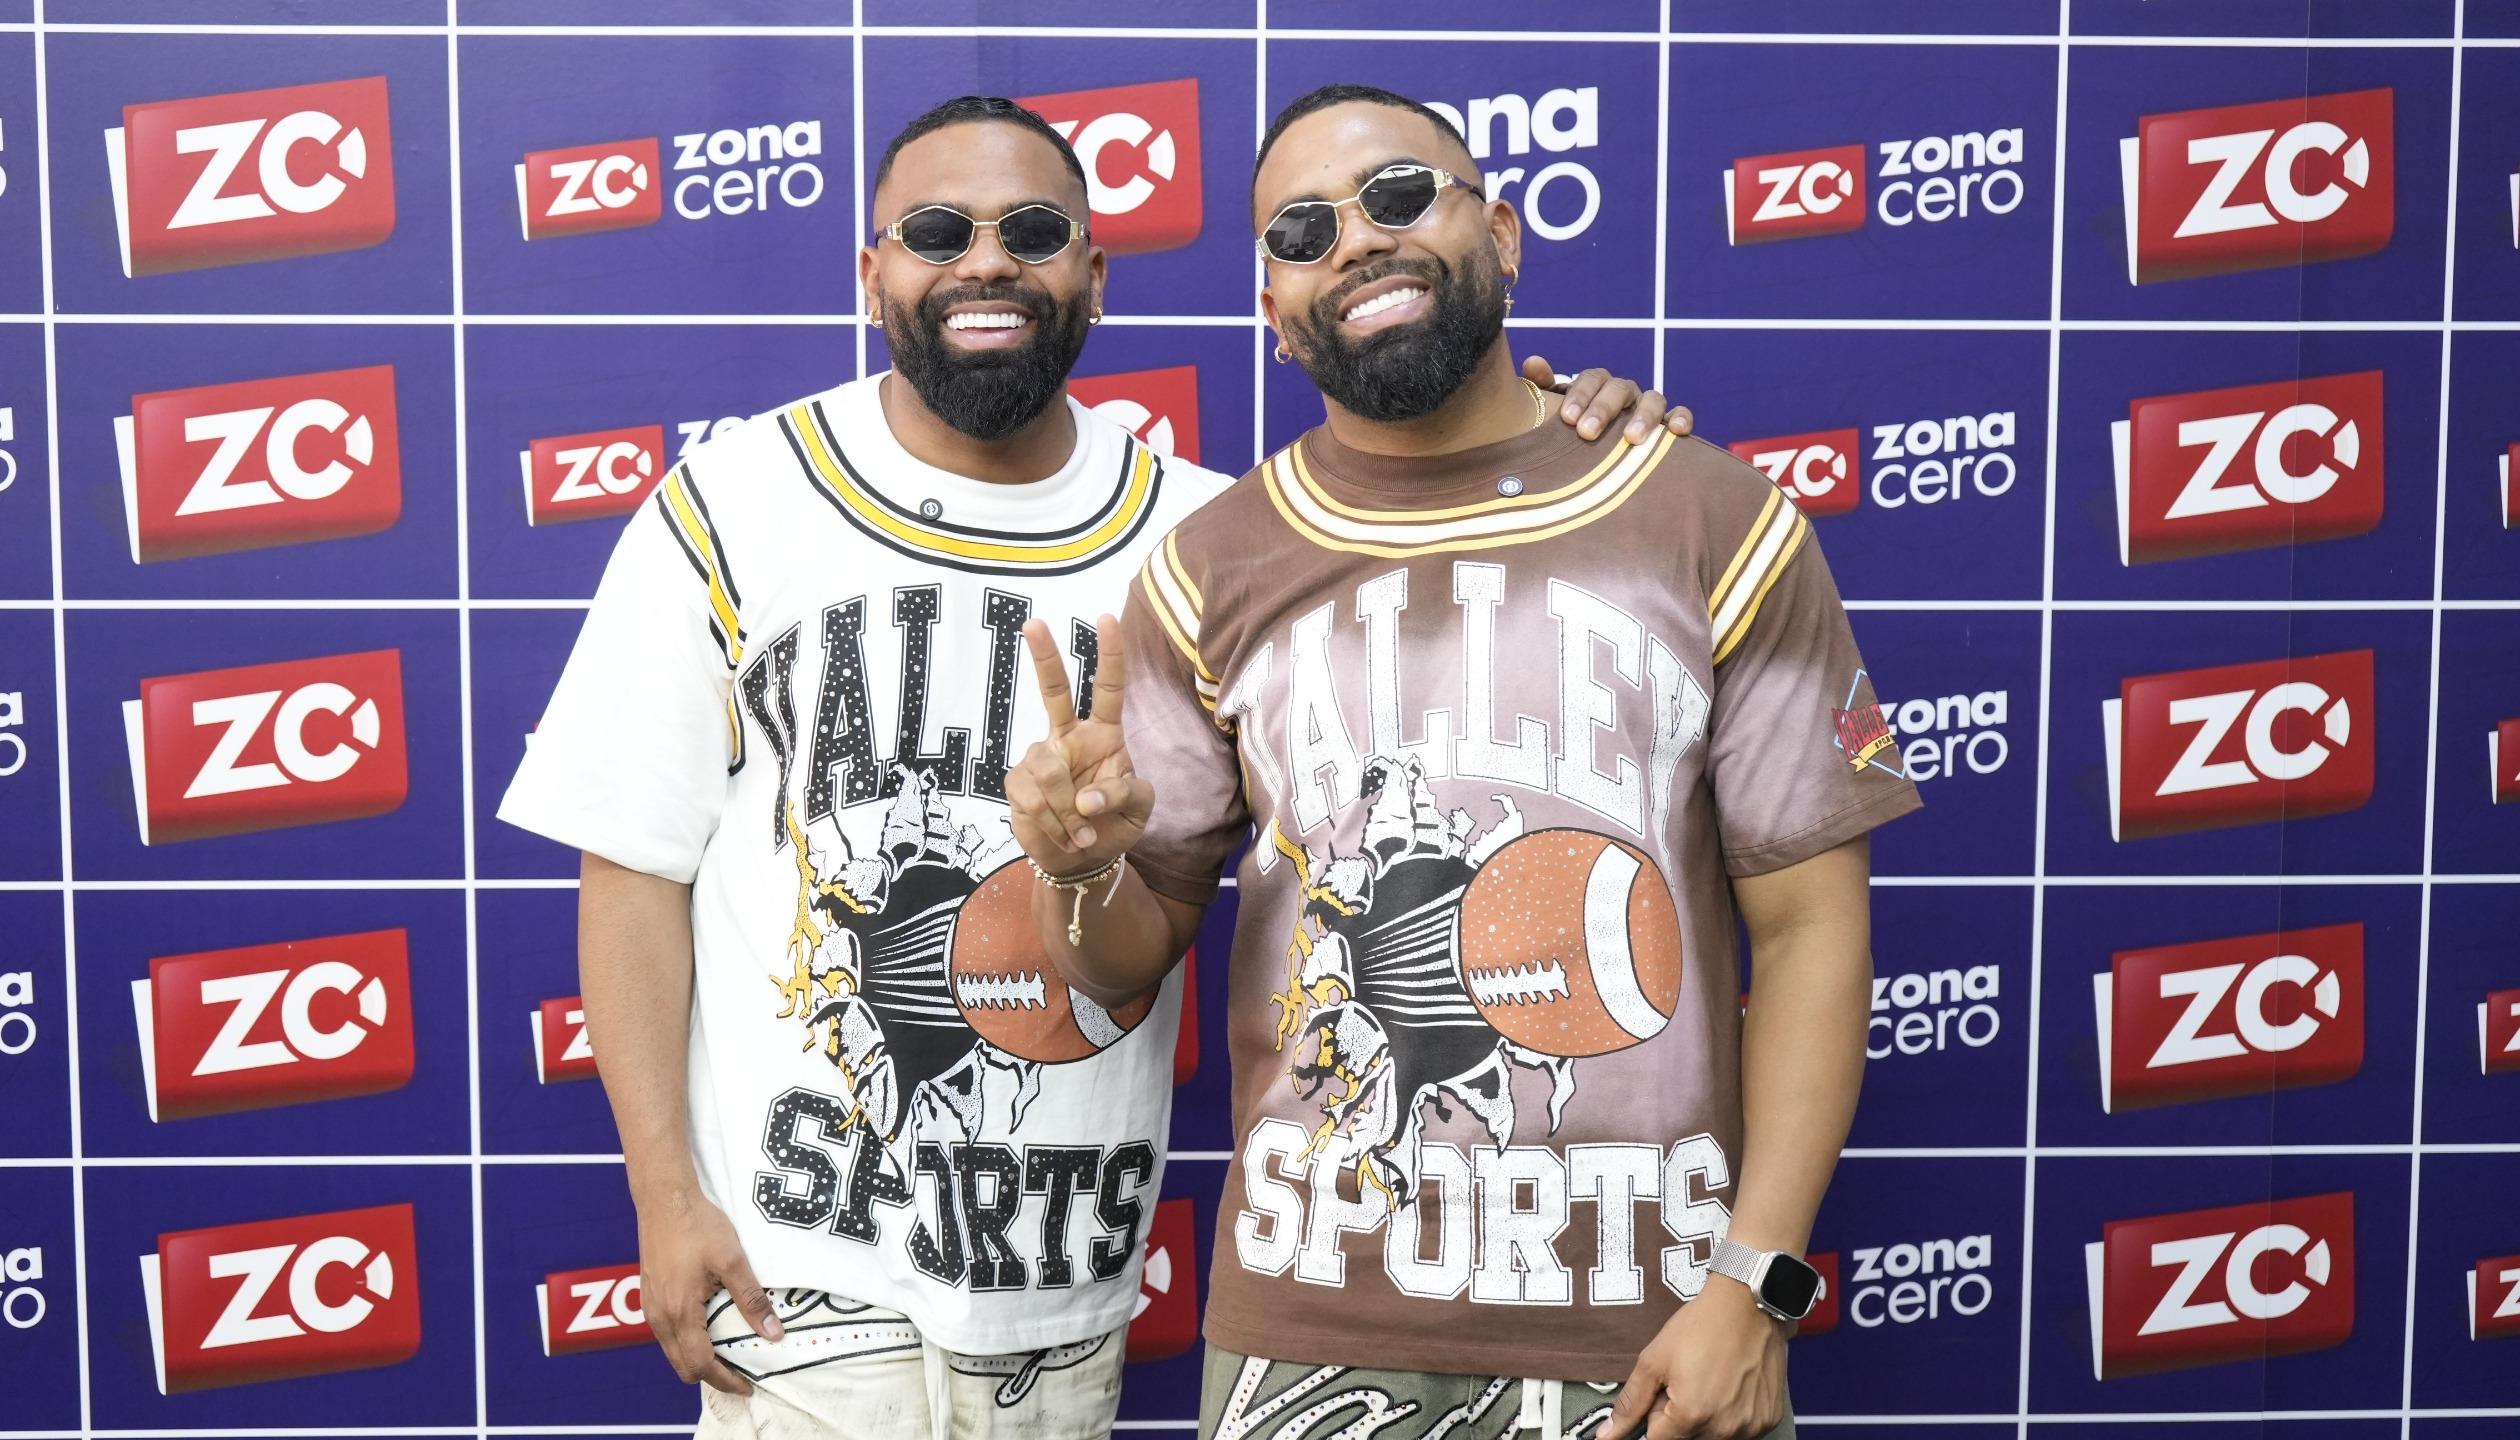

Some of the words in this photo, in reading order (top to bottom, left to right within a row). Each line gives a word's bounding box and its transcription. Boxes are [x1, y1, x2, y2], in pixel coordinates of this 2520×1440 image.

[673, 120, 821, 170] zona
[1422, 87, 1598, 159] na
[1879, 128, 2023, 177] zona
[167, 111, 366, 229] ZC
[546, 155, 647, 216] ZC
[674, 162, 823, 220] cero
[1049, 112, 1175, 215] C
[1753, 161, 1853, 222] ZC
[1878, 169, 2024, 226] cero
[2174, 122, 2369, 238] ZC
[1485, 162, 1601, 241] ro
[175, 399, 373, 516] ZC
[1872, 412, 2015, 460] zona
[2165, 404, 2359, 519] ZC
[551, 442, 652, 503] ZC
[1871, 452, 2016, 508] cero
[184, 682, 380, 798] ZC
[738, 583, 1099, 854] VALL
[1218, 560, 1711, 892] VALLEY
[1831, 704, 1889, 759] VALLE
[2156, 682, 2350, 796] ZC
[1902, 730, 2008, 782] ero
[192, 962, 386, 1076] ZC
[1871, 965, 1999, 1012] zona
[2147, 955, 2339, 1068] ZC
[1866, 1004, 2000, 1060] cero
[1234, 1117, 1732, 1306] SPORTS
[201, 1236, 393, 1349] ZC
[1852, 1235, 1992, 1282] zona
[2138, 1224, 2330, 1336] ZC
[1851, 1273, 1993, 1328] cero
